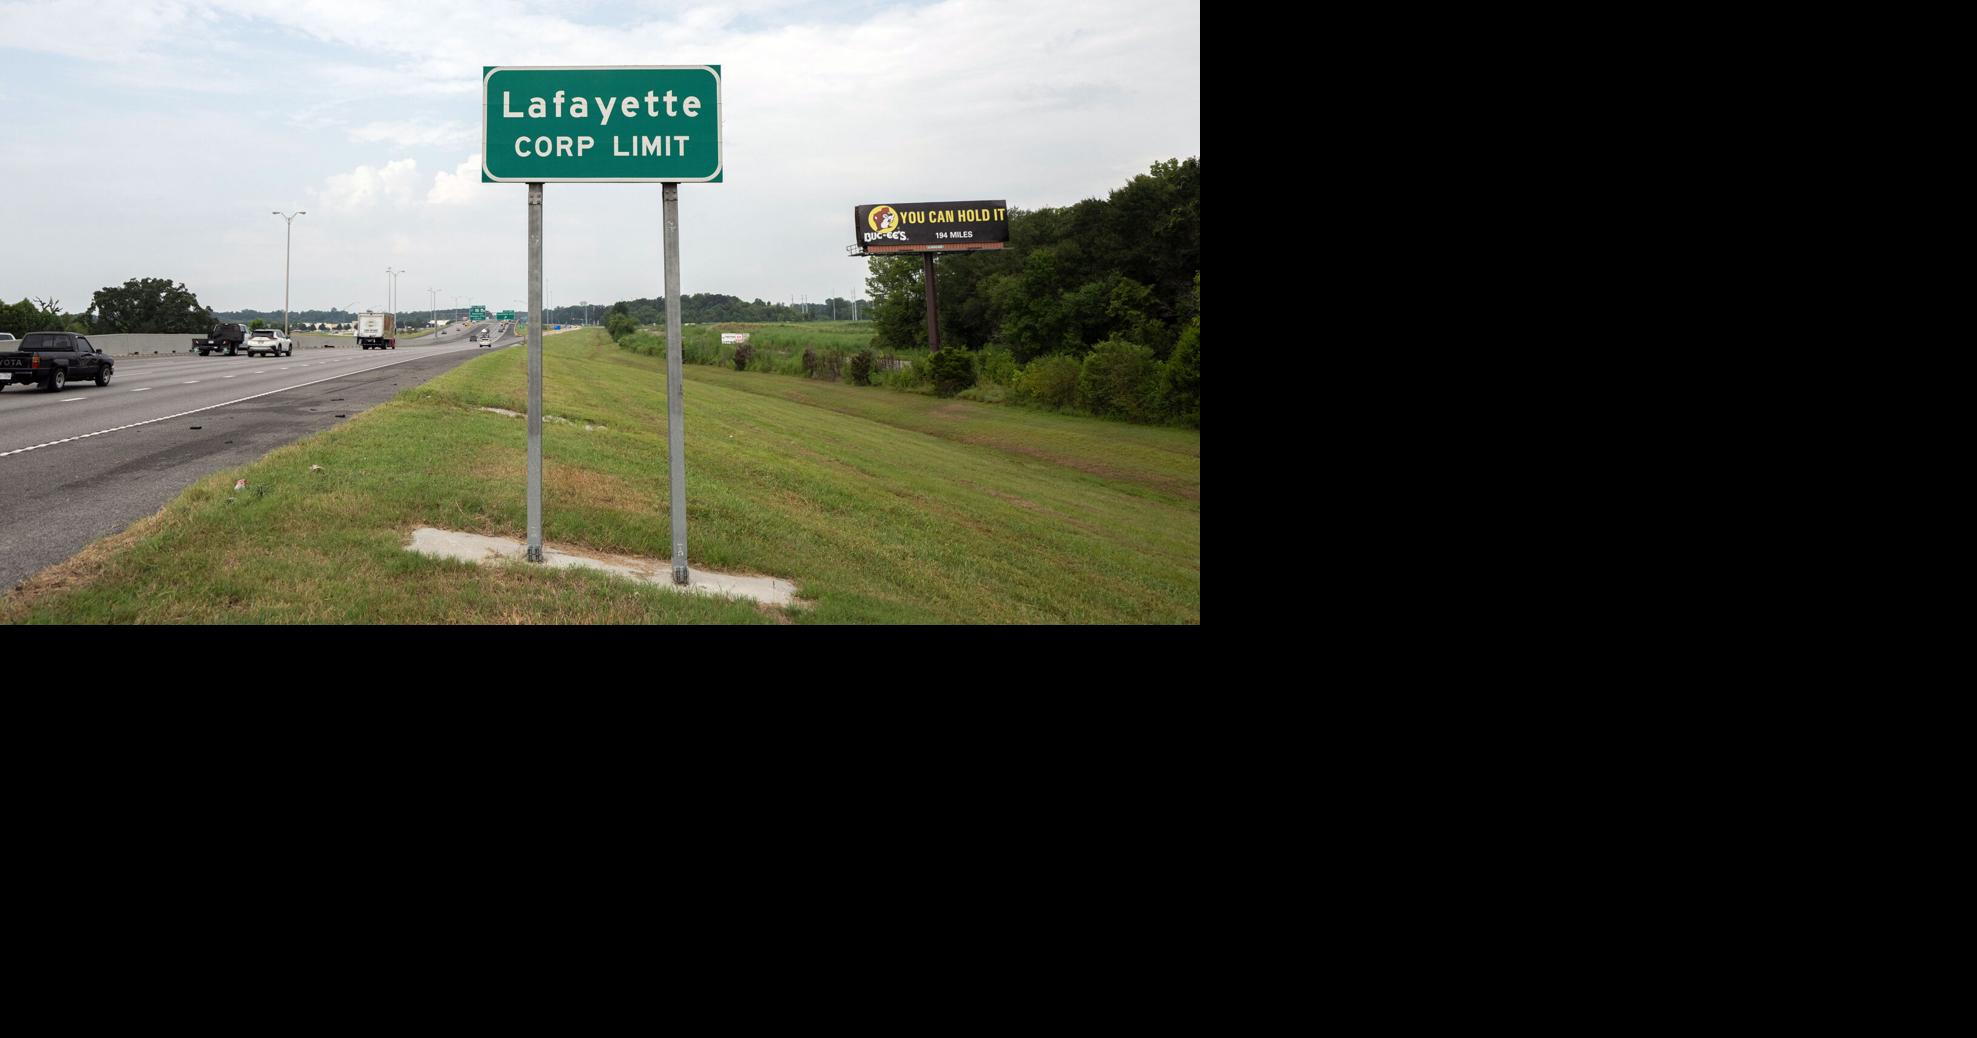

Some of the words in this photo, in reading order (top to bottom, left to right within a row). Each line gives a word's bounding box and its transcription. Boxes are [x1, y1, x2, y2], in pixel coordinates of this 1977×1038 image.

[503, 90, 701, 125] Lafayette
[515, 136, 594, 157] CORP
[613, 136, 690, 156] LIMIT
[900, 211, 924, 224] YOU
[929, 210, 954, 223] CAN
[959, 209, 990, 222] HOLD
[994, 208, 1005, 221] IT
[950, 231, 973, 239] MILES
